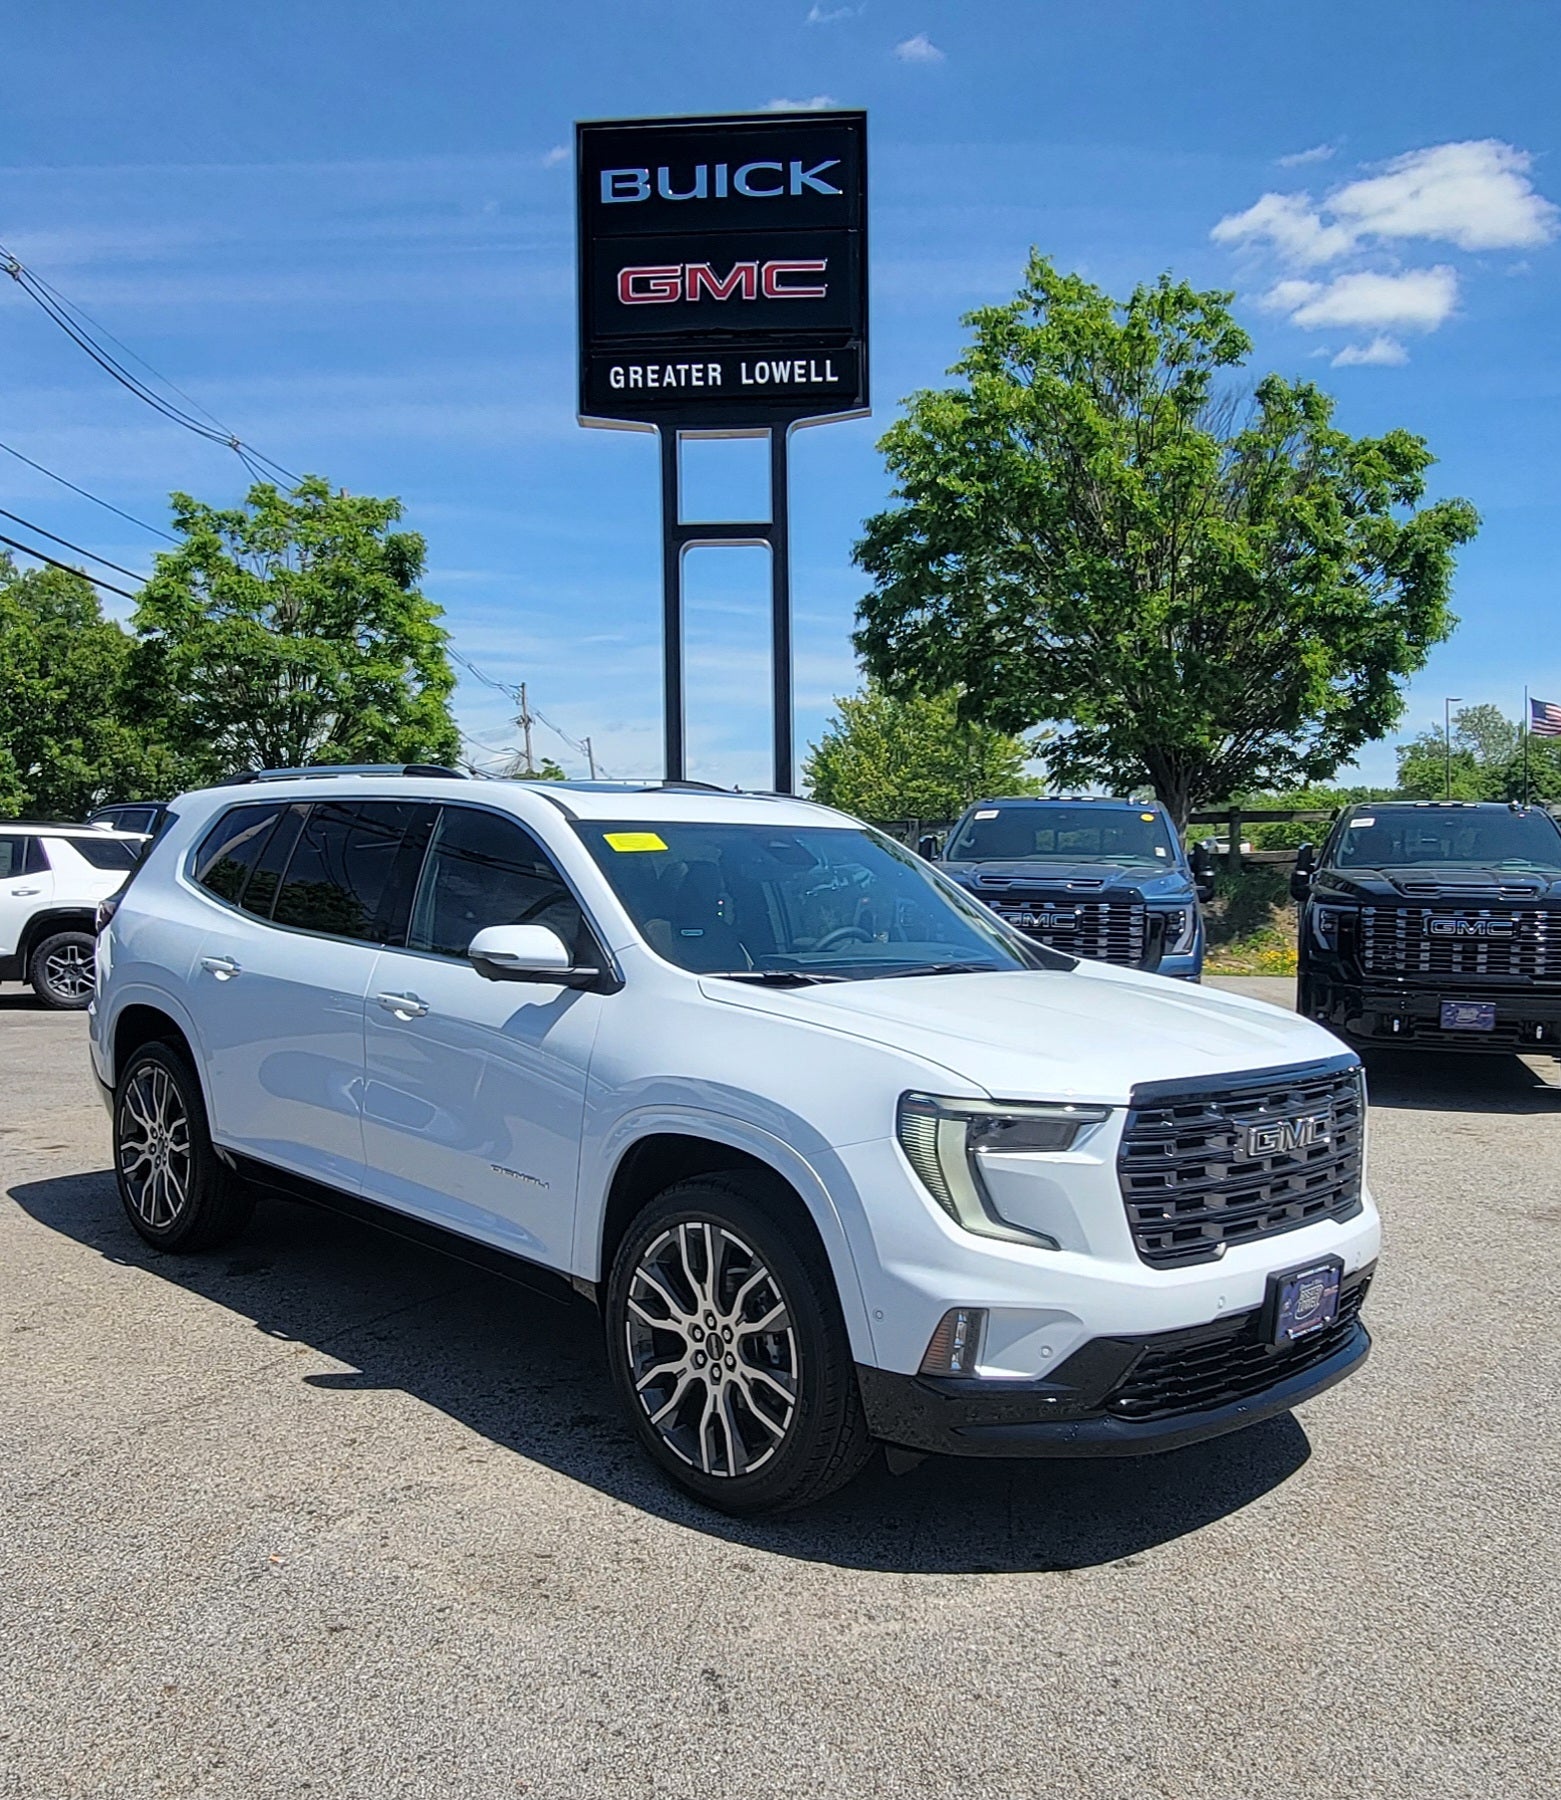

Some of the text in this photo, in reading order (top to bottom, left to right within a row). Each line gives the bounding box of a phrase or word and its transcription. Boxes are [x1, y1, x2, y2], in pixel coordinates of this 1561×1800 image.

[600, 160, 843, 203] BUICK
[617, 258, 828, 305] GMC
[609, 360, 839, 389] GREATER LOWELL
[999, 911, 1075, 928] GMC
[1430, 919, 1513, 936] GMC
[1248, 1115, 1332, 1156] GMC
